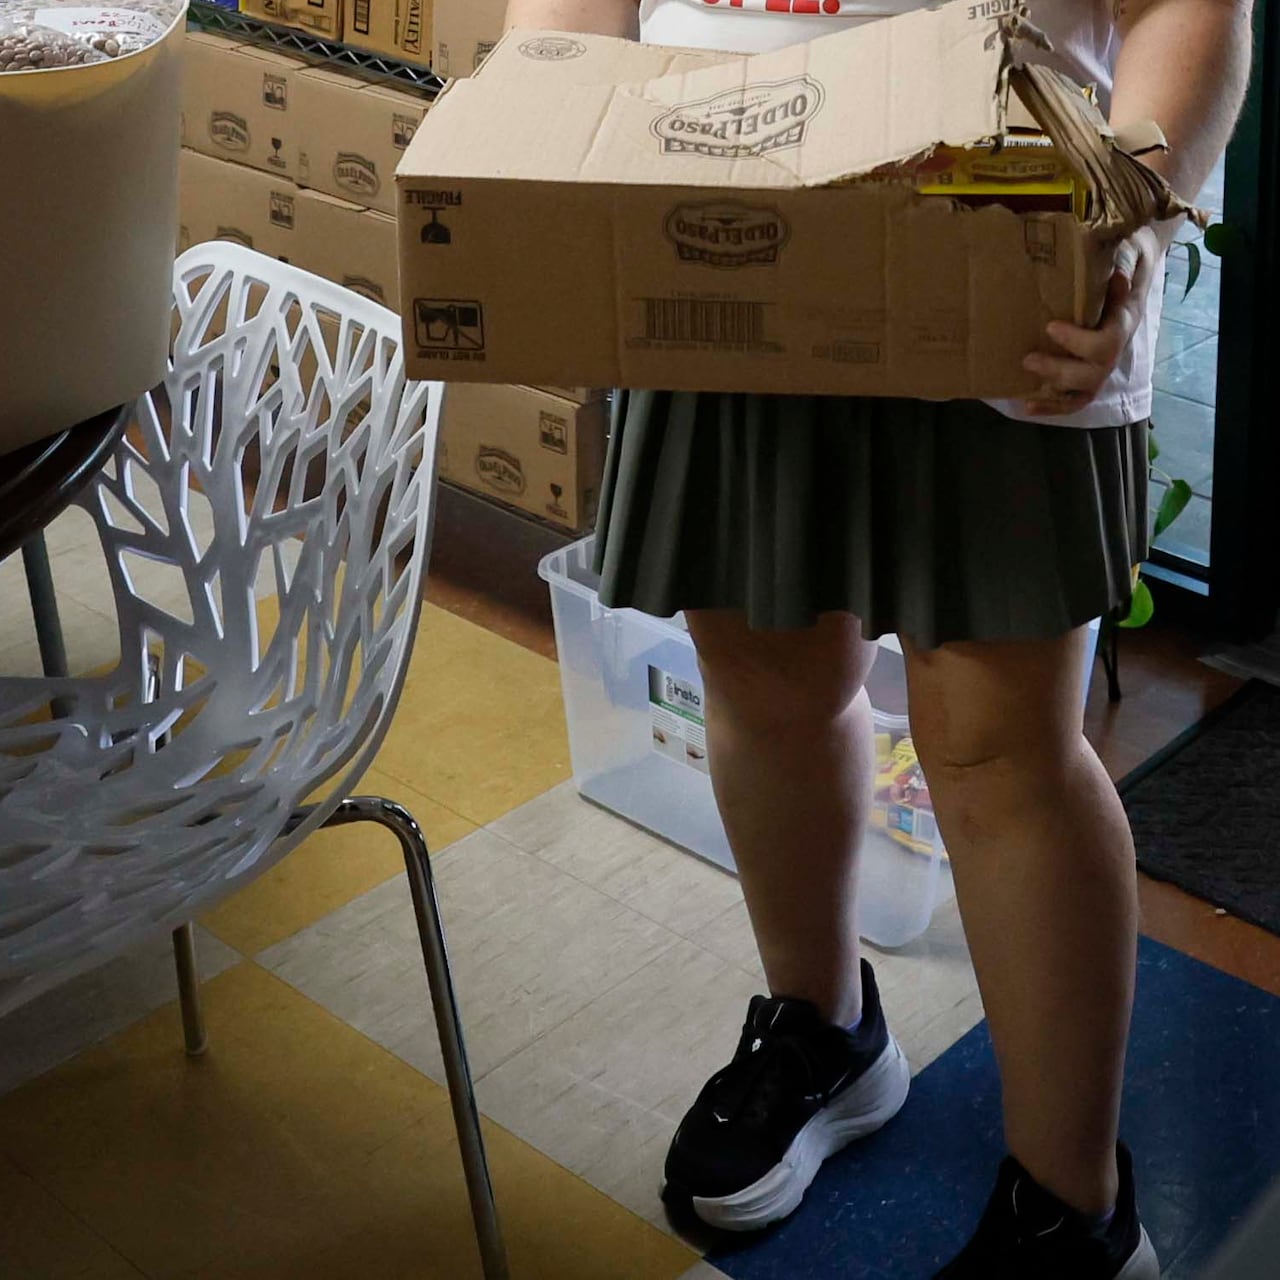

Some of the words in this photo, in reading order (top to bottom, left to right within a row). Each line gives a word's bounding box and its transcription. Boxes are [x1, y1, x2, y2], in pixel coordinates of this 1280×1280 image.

[762, 93, 808, 126] OLD
[736, 114, 760, 135] EL
[405, 189, 462, 206] FRAGILE
[723, 227, 744, 246] EL
[744, 222, 779, 242] OLD
